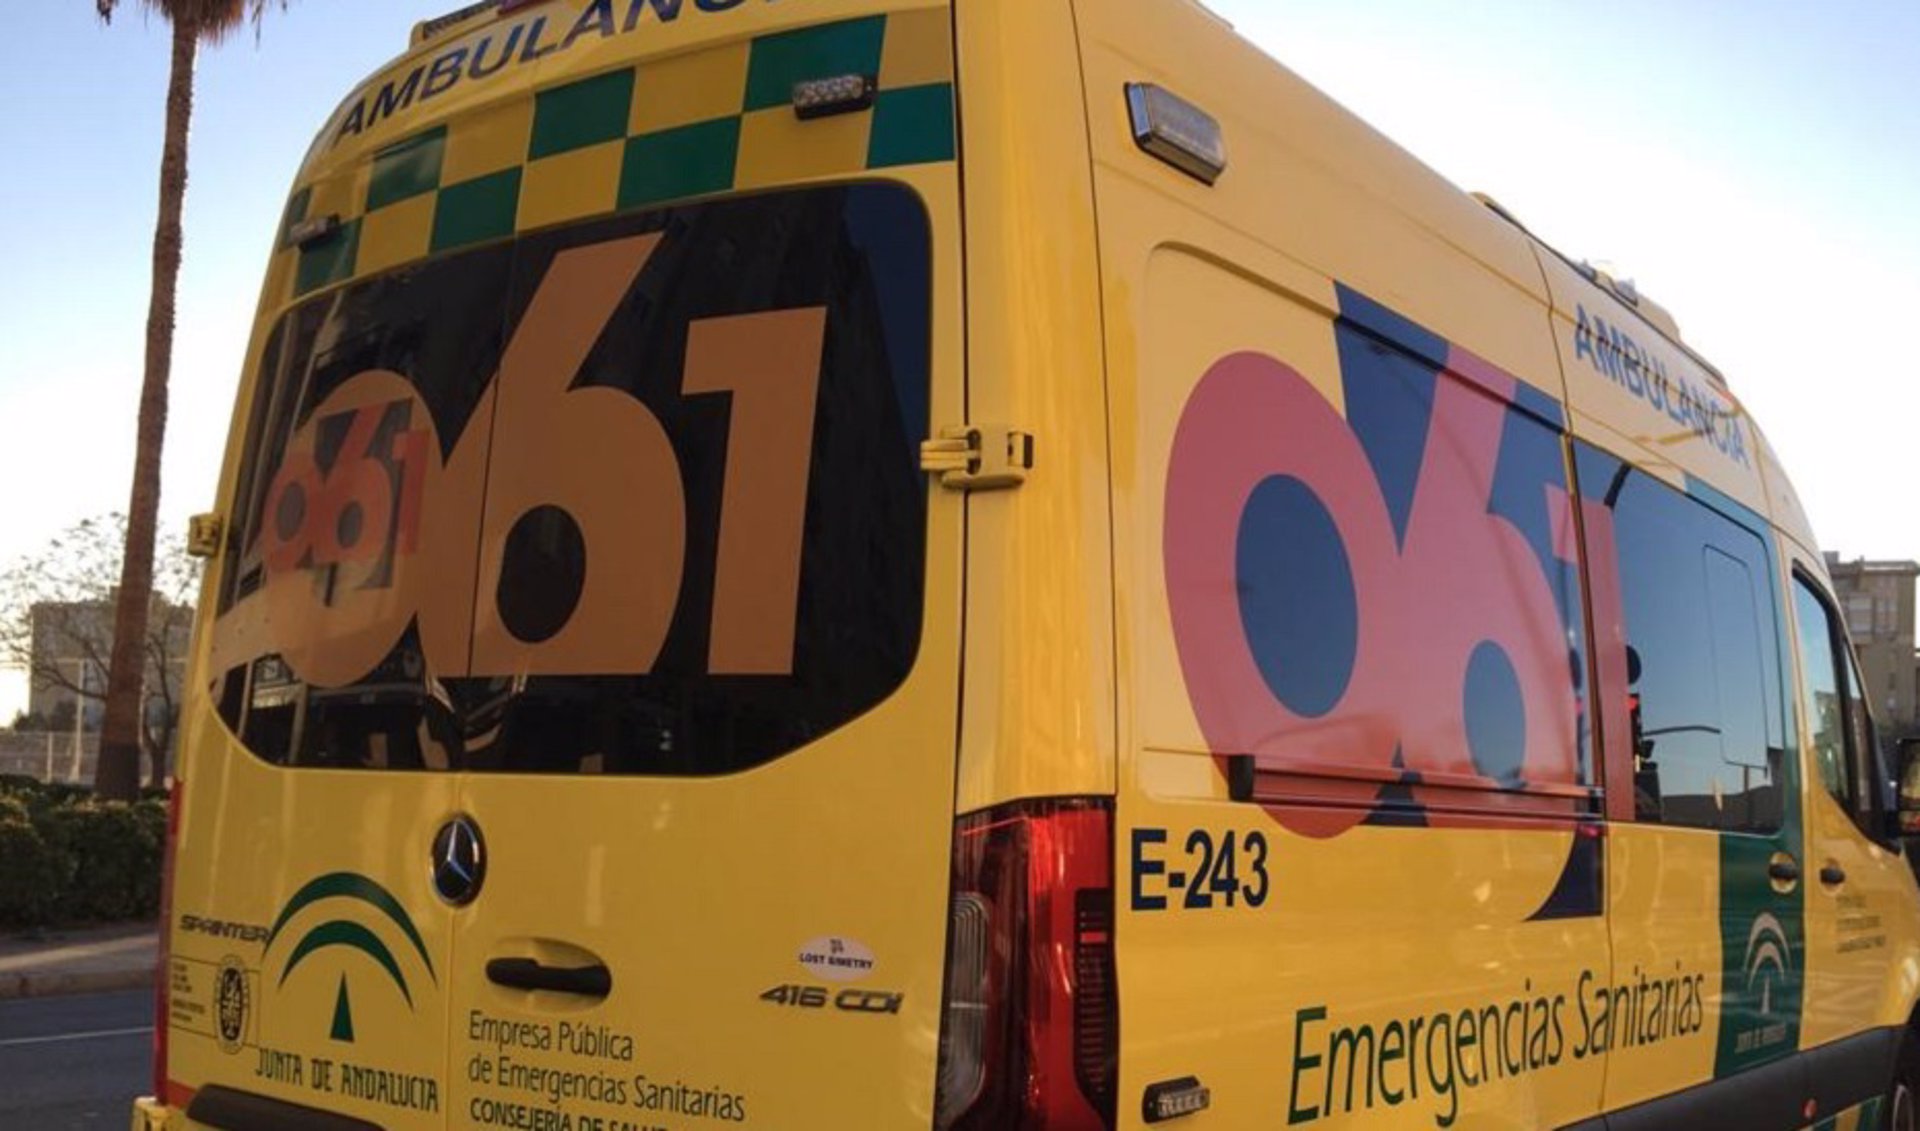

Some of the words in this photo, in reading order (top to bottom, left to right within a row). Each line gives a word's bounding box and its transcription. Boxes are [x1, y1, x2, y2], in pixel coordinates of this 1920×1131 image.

[332, 0, 758, 147] AMBULAN
[1575, 303, 1751, 470] AMBULANCIA
[265, 231, 827, 688] 061
[1163, 342, 1636, 839] 061
[1131, 827, 1269, 911] E-243
[180, 914, 272, 943] SPRINTER
[469, 1010, 551, 1051] Empresa
[558, 1021, 634, 1061] Pública
[760, 984, 828, 1009] 416
[835, 988, 904, 1015] CDI
[256, 1048, 302, 1086] JUNTA
[311, 1058, 333, 1092] DE
[1287, 977, 1566, 1128] Emergencias
[1573, 961, 1705, 1060] Sanitarias
[468, 1053, 492, 1085] de
[497, 1056, 627, 1105] Emergencias
[634, 1074, 745, 1122] Sanitarias
